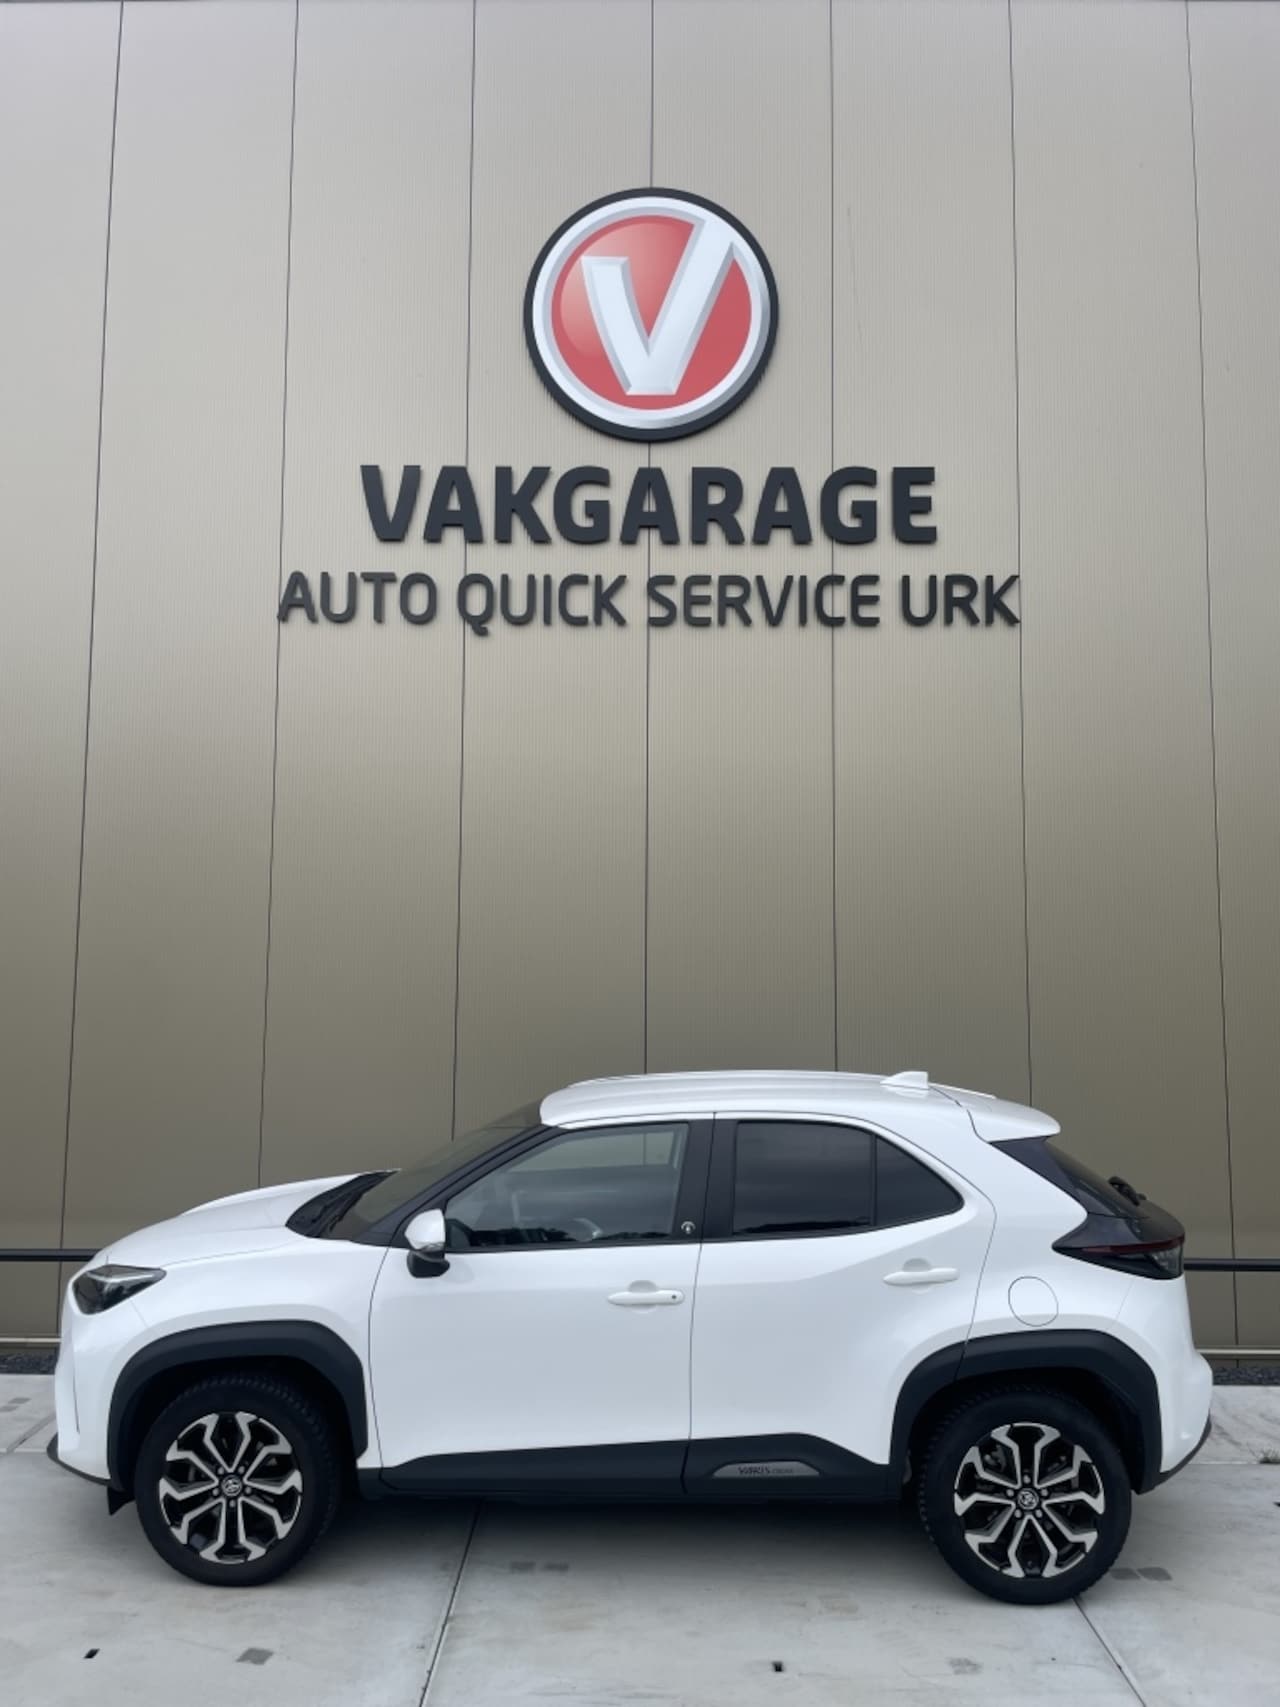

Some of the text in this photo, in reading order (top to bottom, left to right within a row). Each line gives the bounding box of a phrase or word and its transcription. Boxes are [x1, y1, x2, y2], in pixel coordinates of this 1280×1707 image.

[580, 214, 735, 396] V
[360, 465, 937, 545] VAKGARAGE
[277, 571, 1021, 636] AUTO QUICK SERVICE URK
